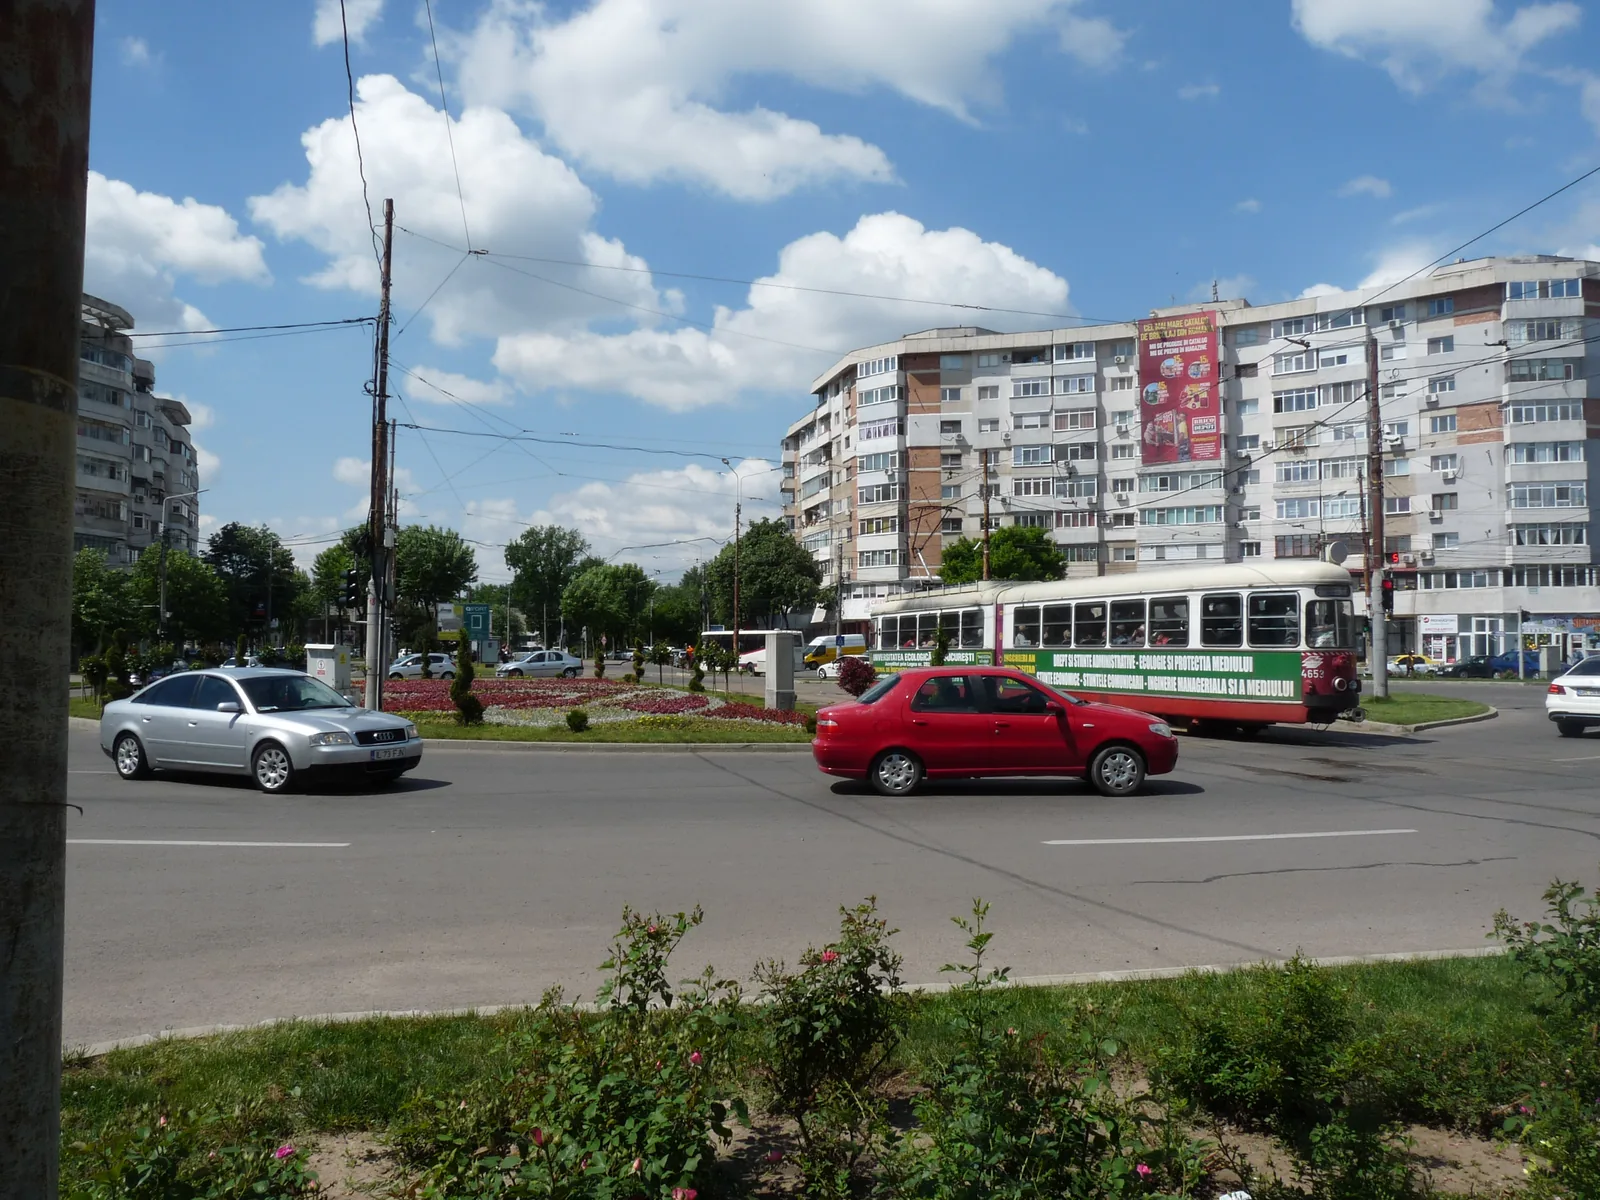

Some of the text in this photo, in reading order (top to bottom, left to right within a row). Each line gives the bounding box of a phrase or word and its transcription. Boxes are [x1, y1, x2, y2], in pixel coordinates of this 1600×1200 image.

[1167, 320, 1184, 328] MARE
[1149, 329, 1176, 340] BRILAJ
[1177, 329, 1187, 337] DIN
[873, 653, 904, 661] UNIVERSITATEA
[1053, 654, 1068, 667] DREPT
[1092, 654, 1136, 669] ADMINISTRATIVE
[1139, 654, 1166, 670] ECOLOGIE
[1175, 655, 1211, 671] PROTECTIA
[1212, 656, 1253, 672] MEDIULUI
[1301, 669, 1324, 679] 4653
[1053, 671, 1080, 687] ECONOMICE
[1107, 674, 1144, 690] COMUNICARII
[1147, 675, 1177, 692] INGINERIE
[1178, 676, 1227, 694] MANAGERIALA
[1228, 678, 1237, 695] SI
[1238, 679, 1246, 695] A
[1247, 679, 1294, 697] MEDIULUI
